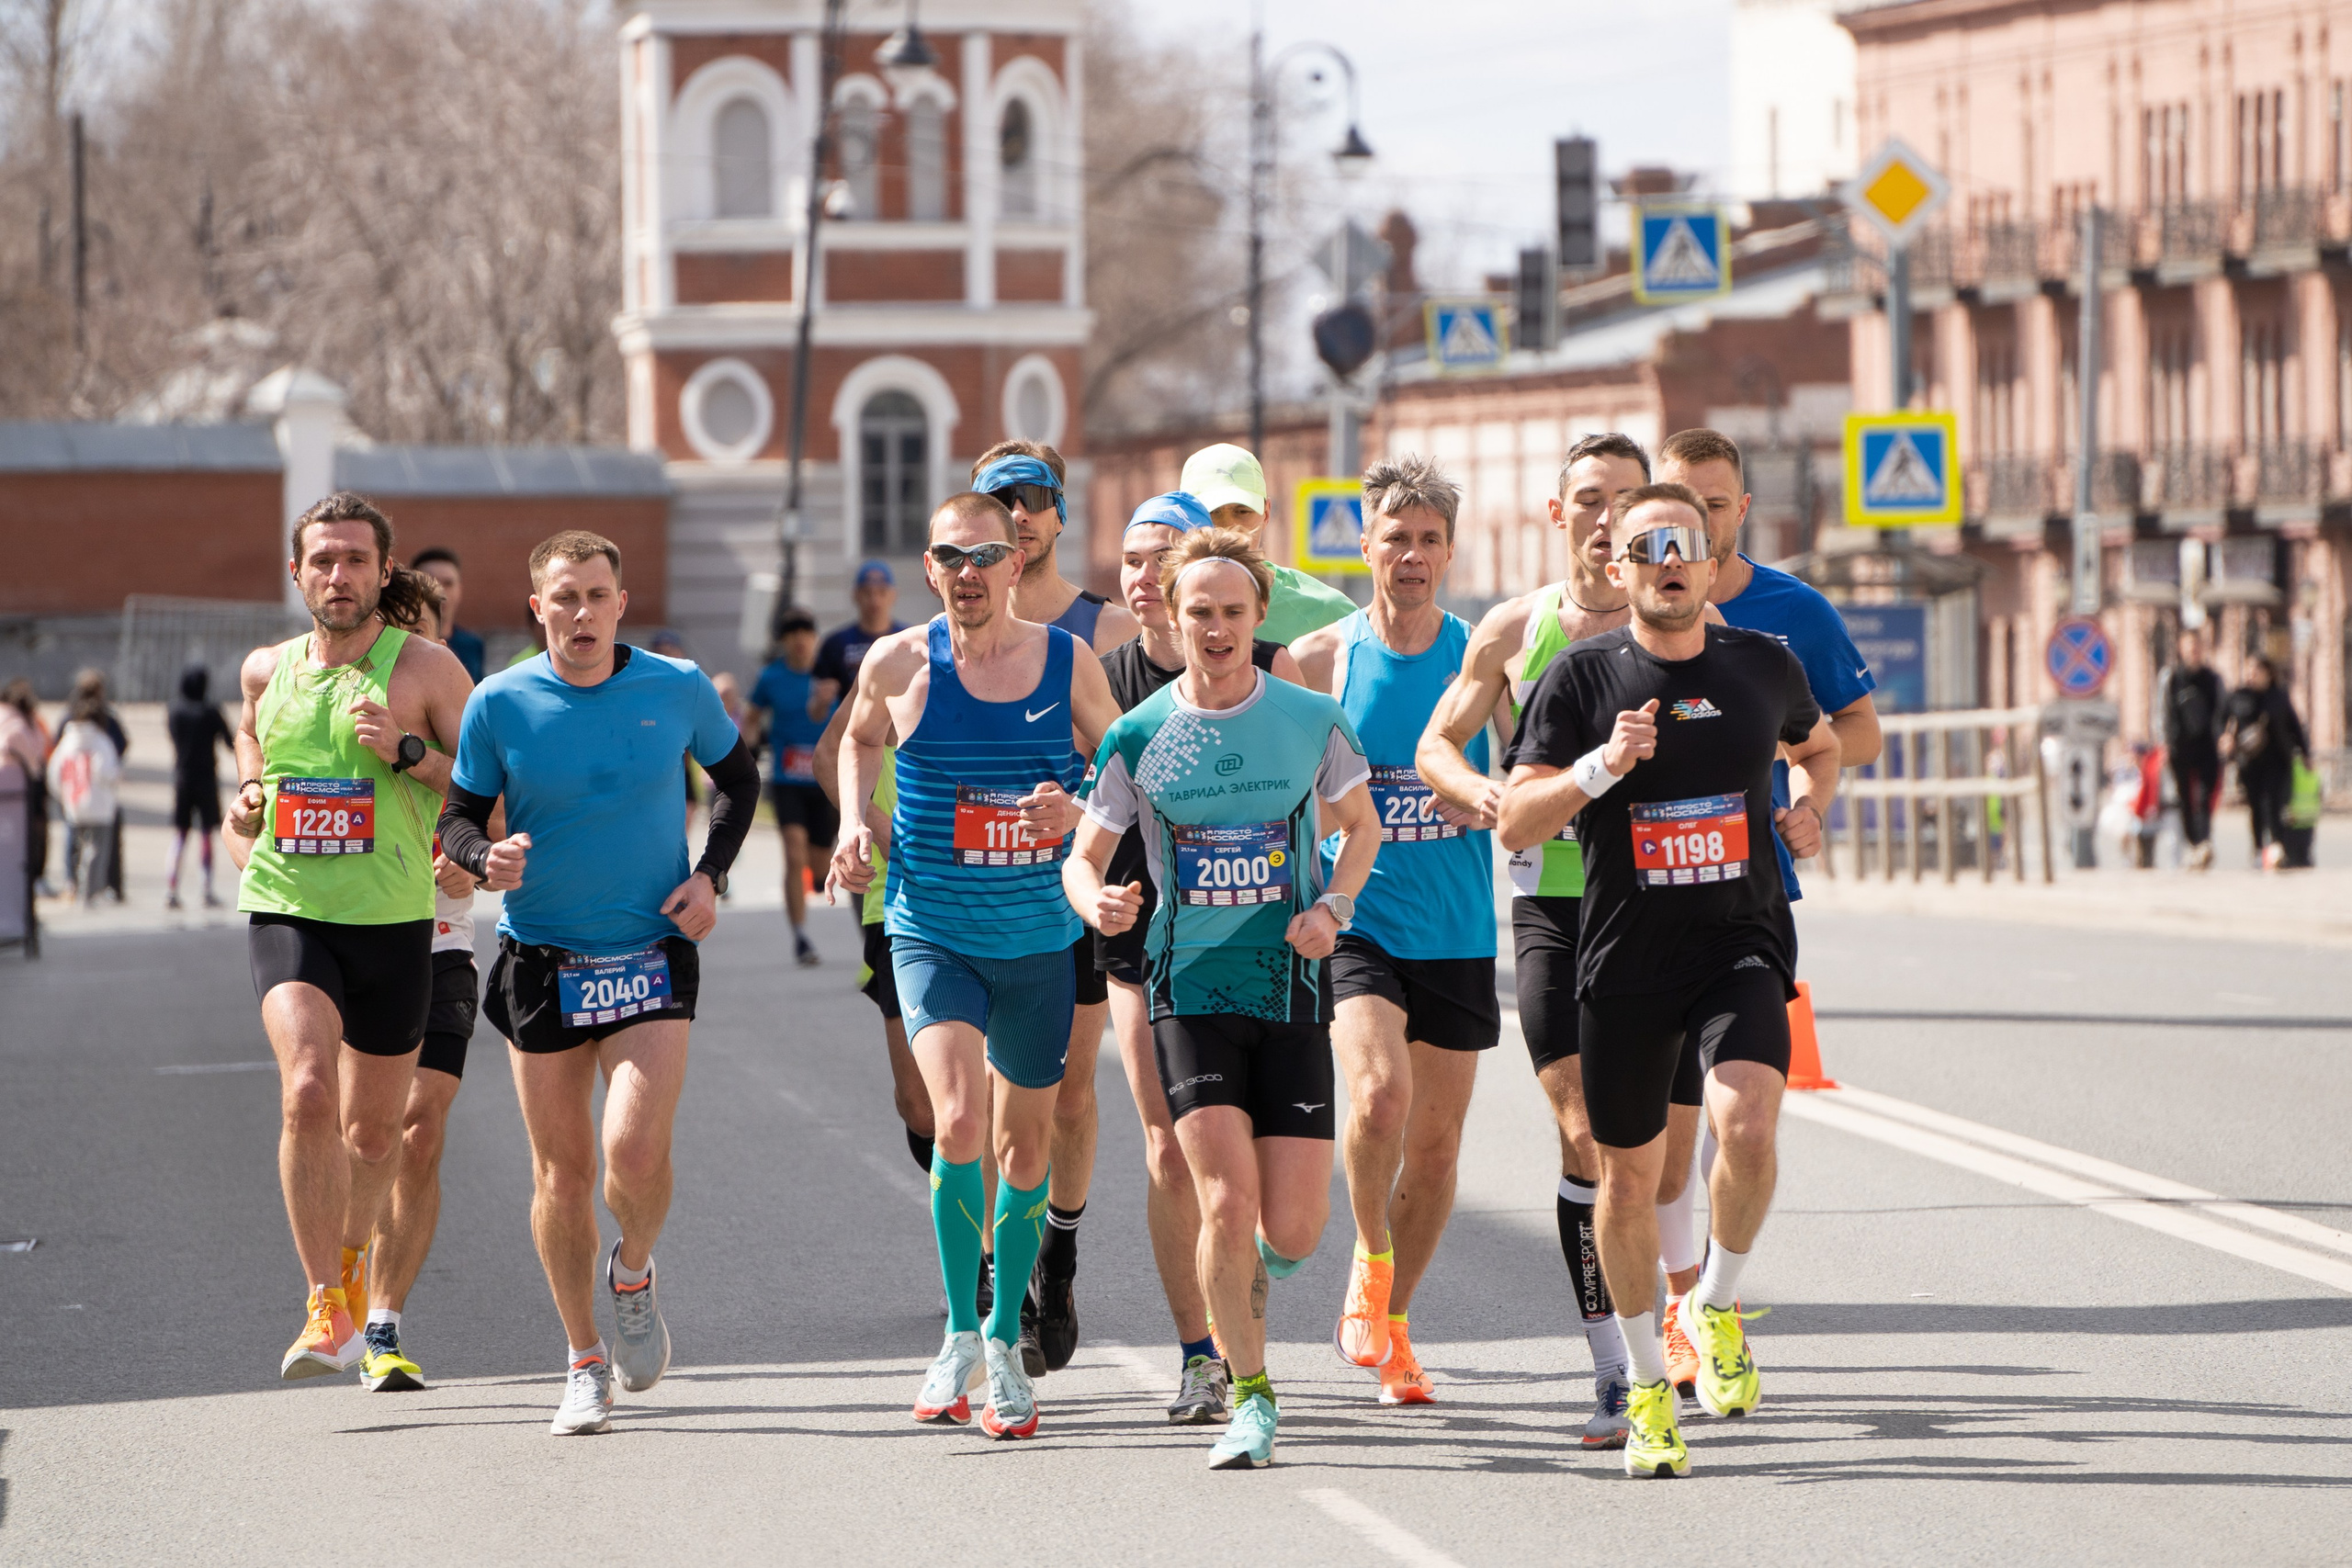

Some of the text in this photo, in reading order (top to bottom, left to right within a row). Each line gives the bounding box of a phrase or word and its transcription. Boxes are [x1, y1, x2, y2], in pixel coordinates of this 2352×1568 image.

[1690, 709, 1723, 719] adidas
[1169, 779, 1291, 803] ТАВРИДА ЭЛЕКТРИК
[989, 797, 1017, 806] КОСМ
[1673, 801, 1713, 811] ПРОСТО
[1385, 795, 1444, 825] 220
[1666, 807, 1713, 818] КОСМОС
[292, 808, 349, 837] 1228
[1678, 821, 1698, 829] ОЛЕГ
[1214, 845, 1241, 853] СЕРГЕЙ
[1661, 830, 1725, 866] 1198
[1197, 856, 1270, 887] 2000
[590, 953, 634, 964] КОСМОС
[594, 965, 626, 976] ВАЛЕРИЙ
[581, 975, 650, 1010] 2040
[1169, 1074, 1223, 1096] BG 3000
